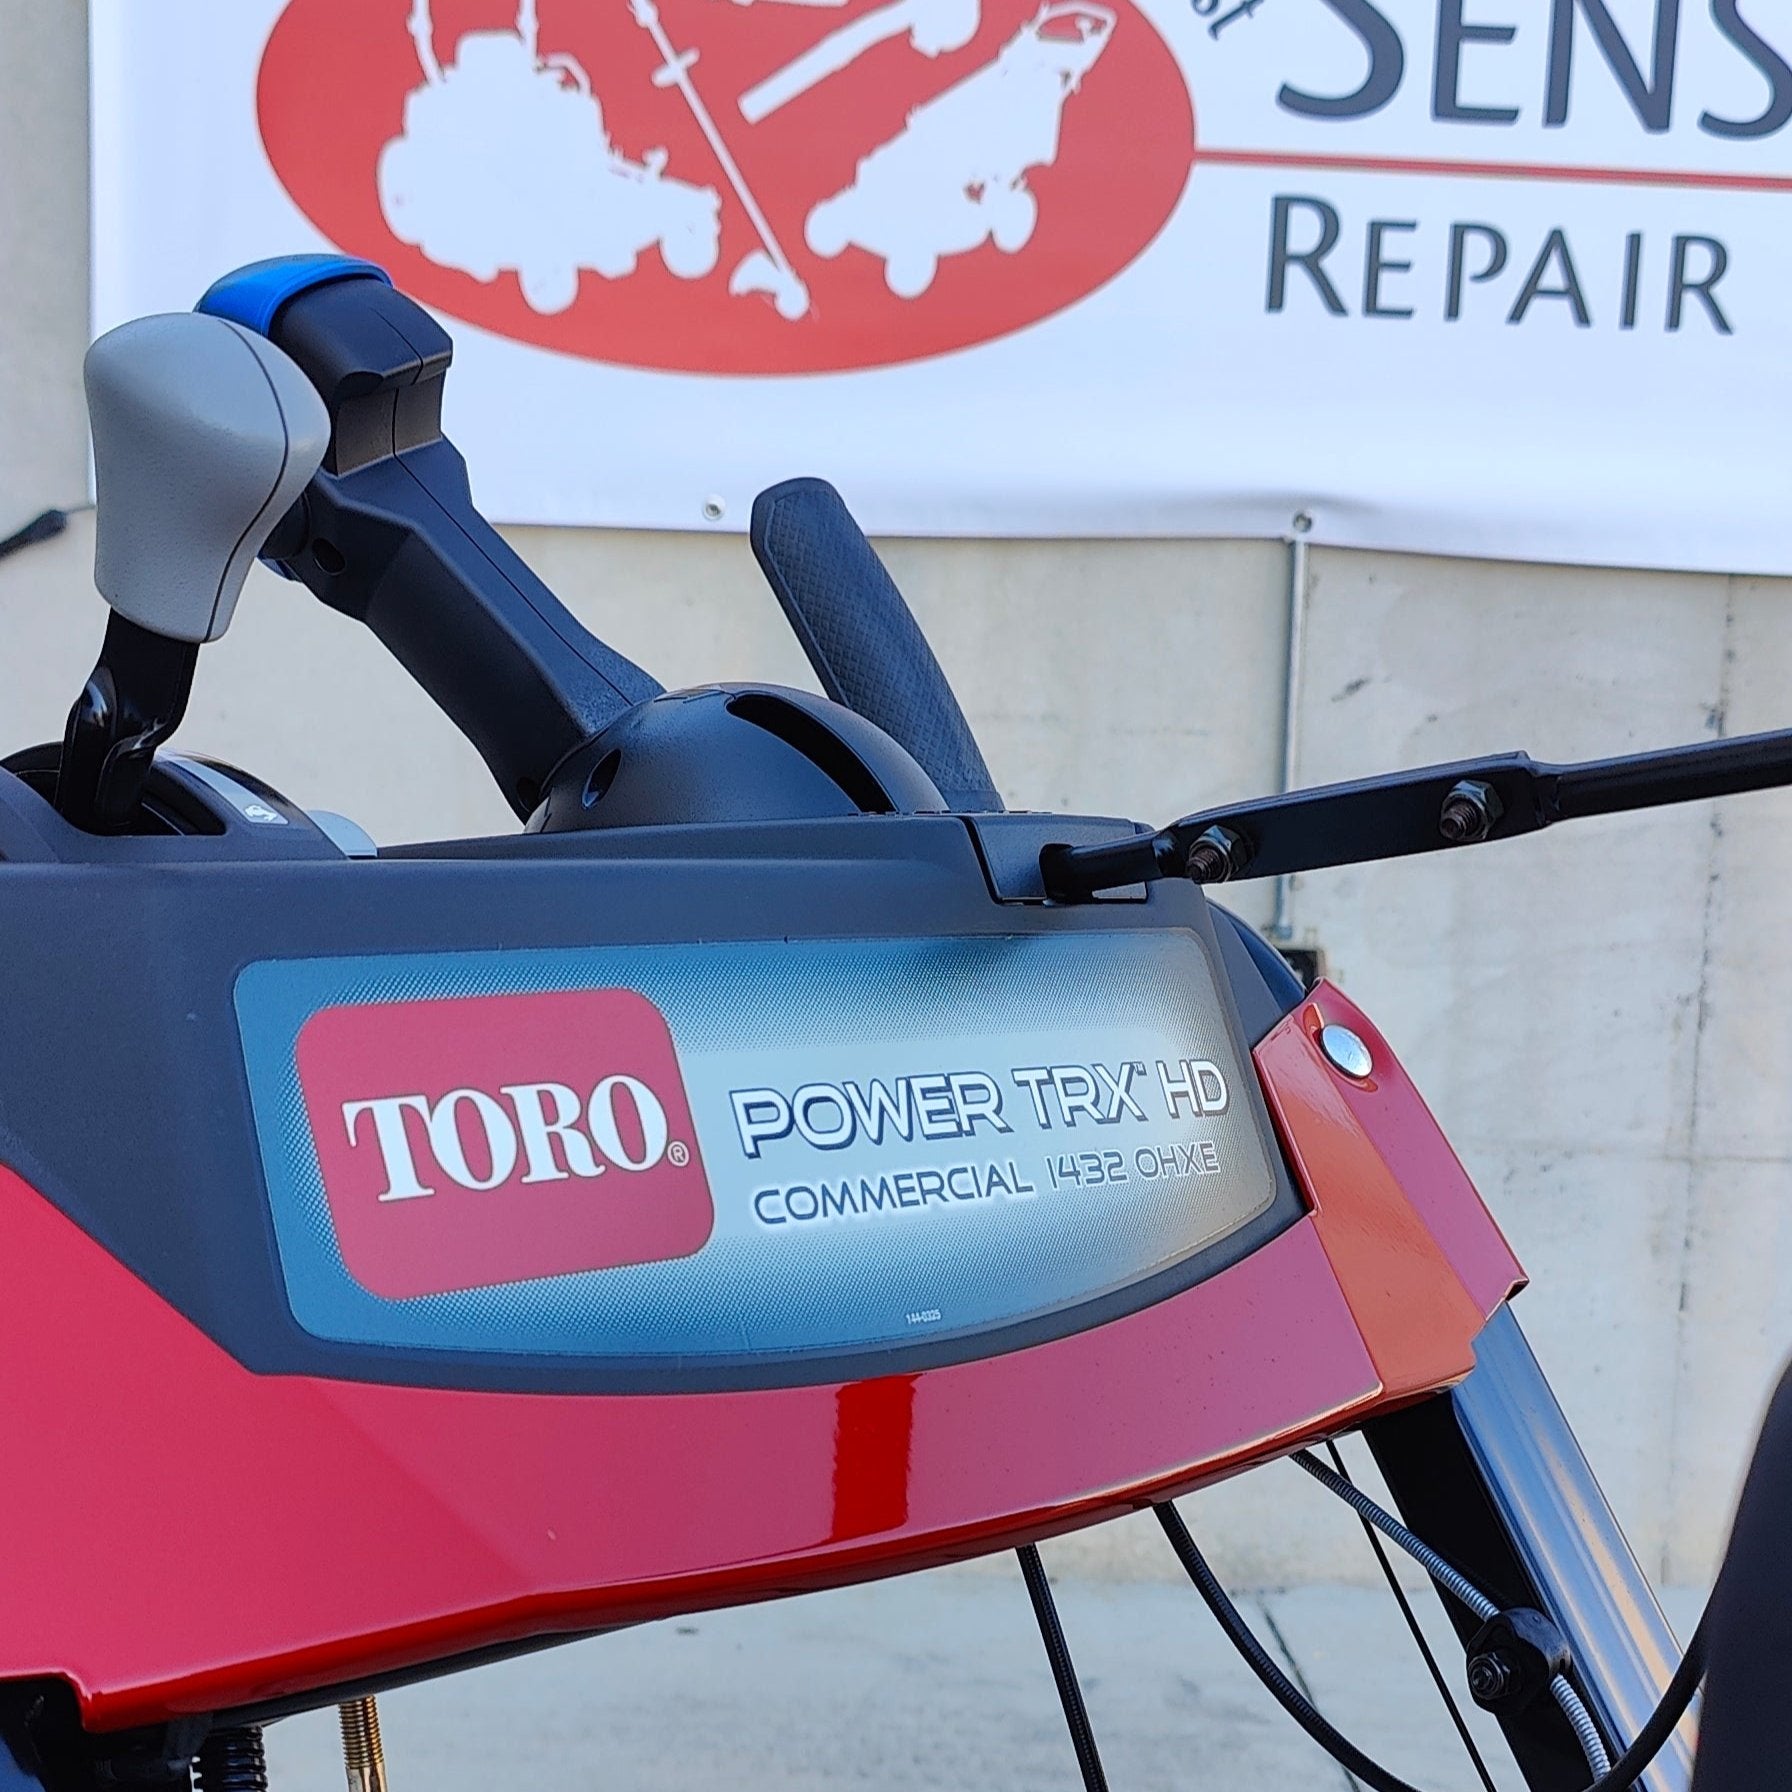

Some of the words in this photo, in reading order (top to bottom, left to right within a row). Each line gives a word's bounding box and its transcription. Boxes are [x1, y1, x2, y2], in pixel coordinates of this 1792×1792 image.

[1265, 193, 1734, 334] REPAIR
[729, 1071, 1014, 1159] POWER
[1156, 1059, 1230, 1119] HD
[754, 1161, 1033, 1224] COMMERCIAL
[1047, 1151, 1128, 1189] 1432
[1135, 1142, 1219, 1178] OHXE
